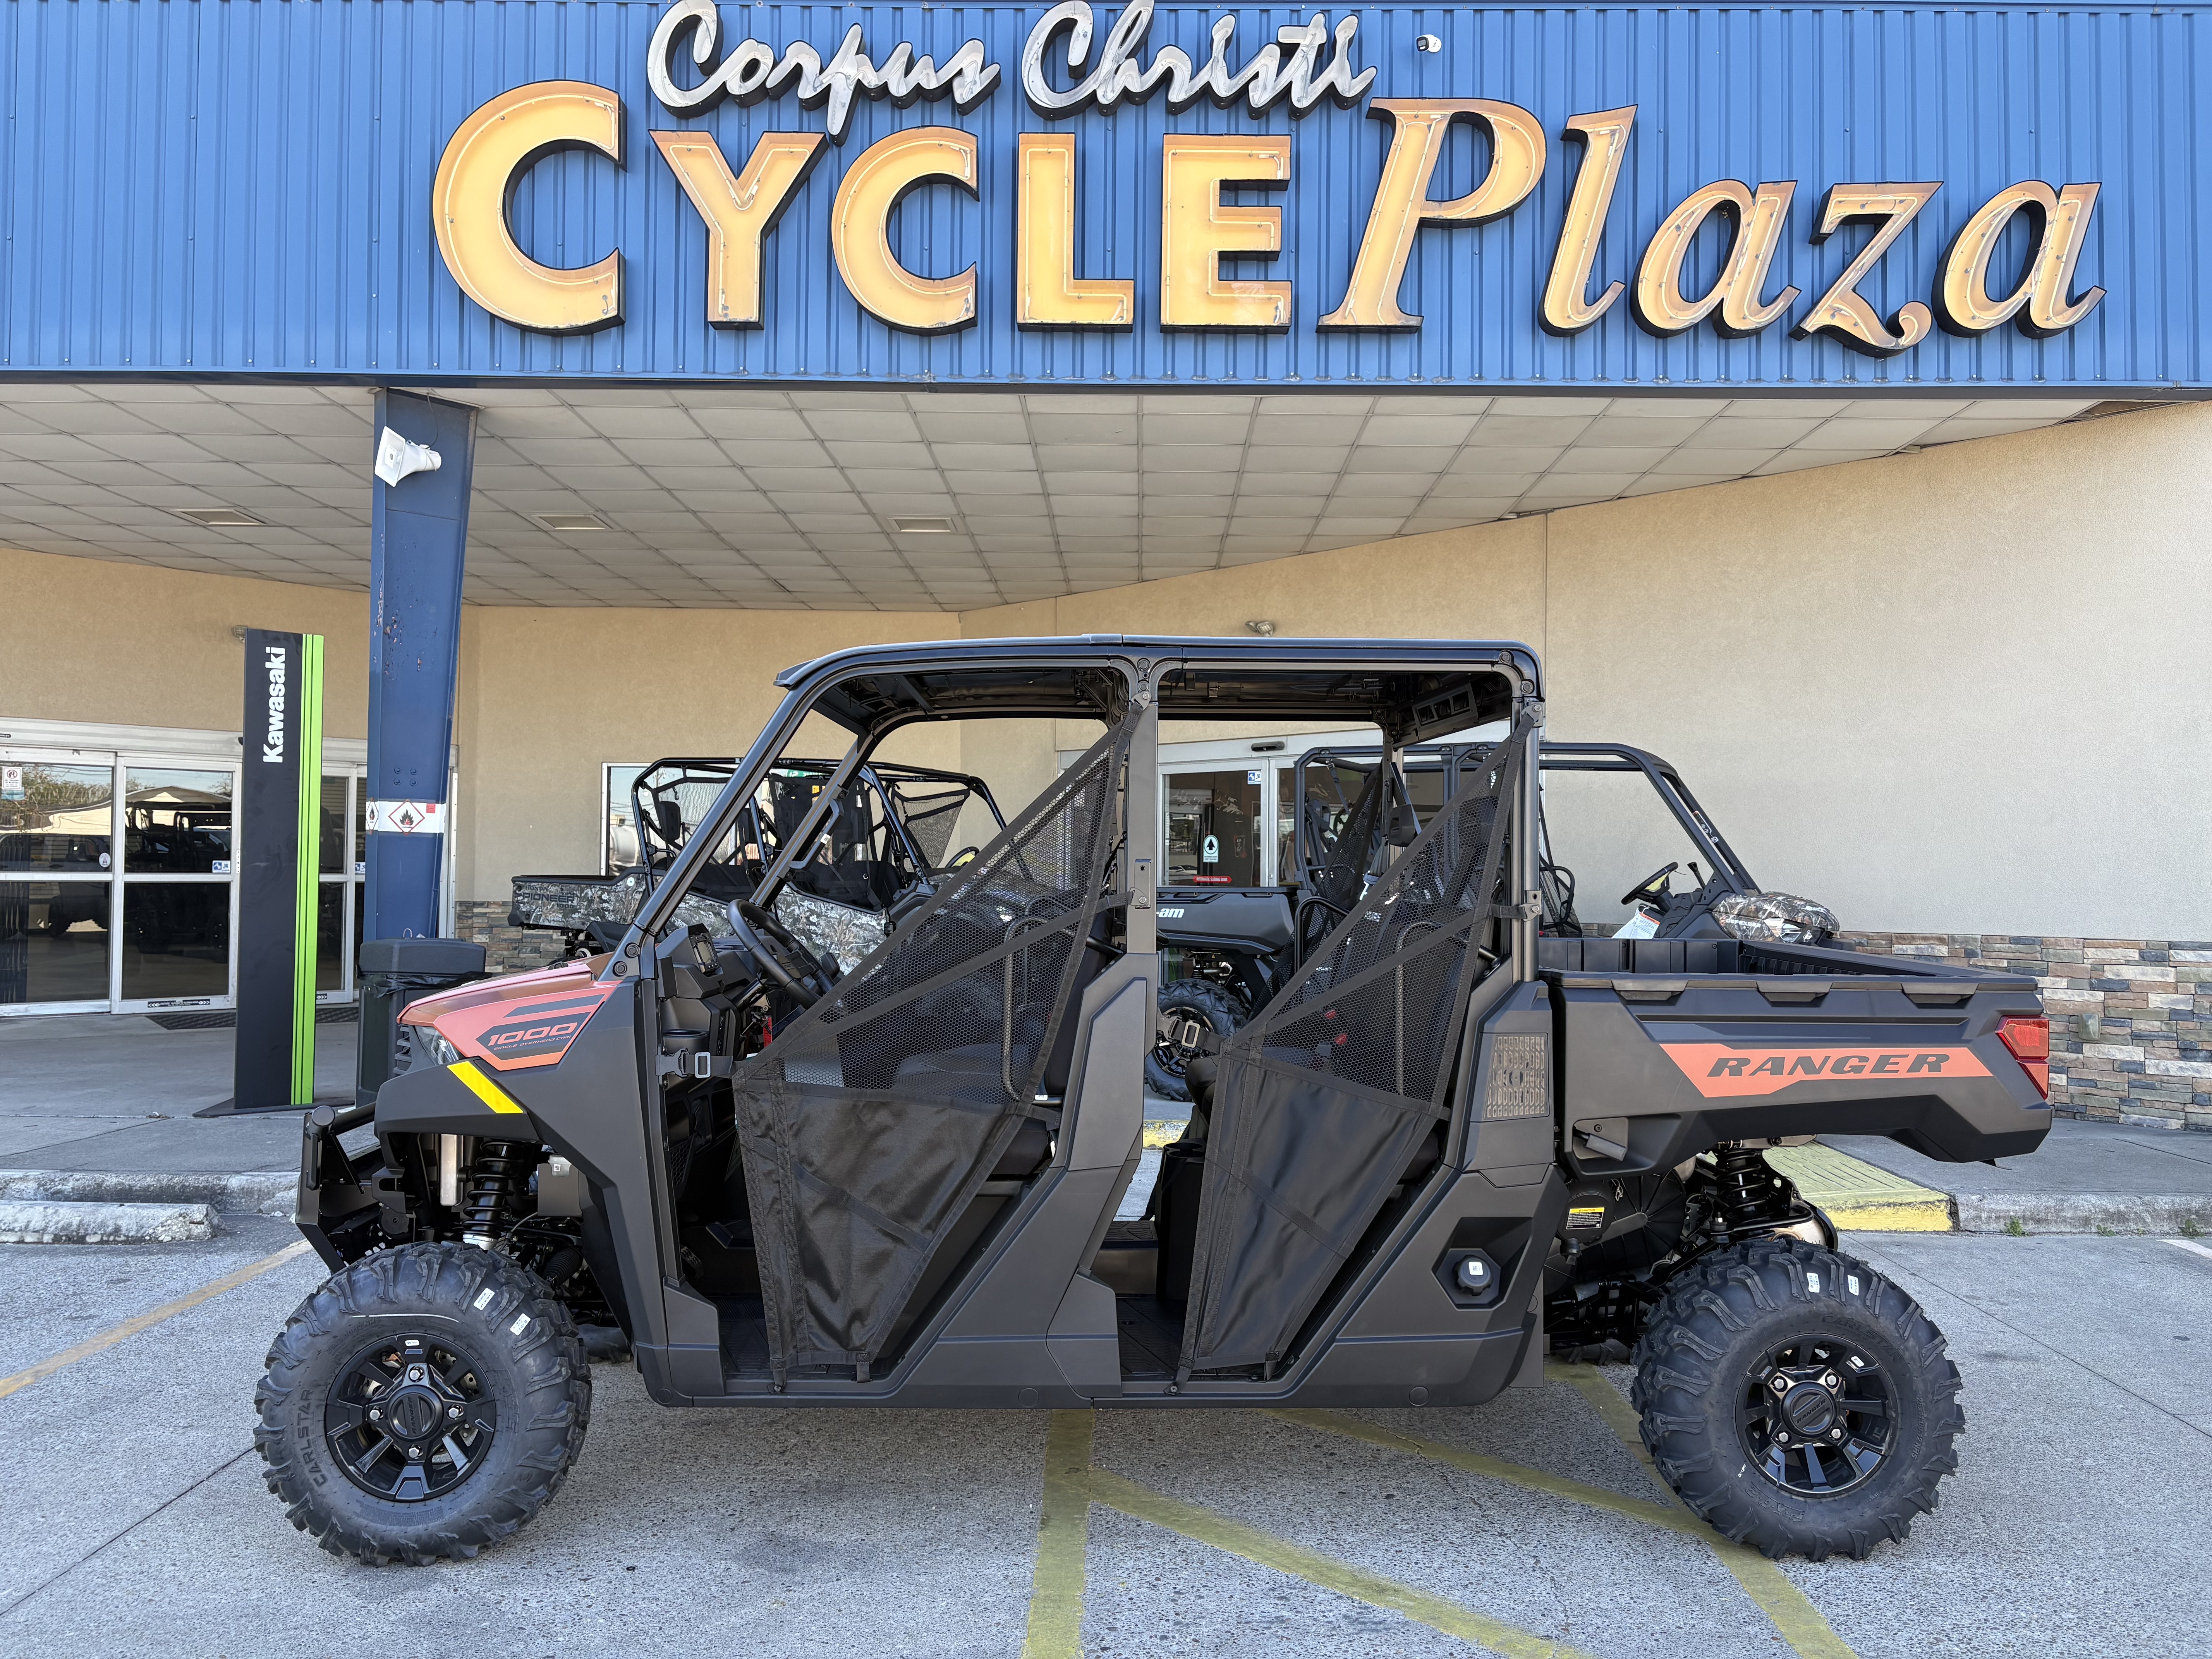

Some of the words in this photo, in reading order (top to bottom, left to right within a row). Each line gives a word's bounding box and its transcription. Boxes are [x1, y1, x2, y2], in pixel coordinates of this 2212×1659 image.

[647, 0, 1001, 145] Corpus
[1022, 0, 1377, 119] Christi
[432, 79, 1292, 335] CYCLE
[1316, 97, 2107, 356] Plaza
[263, 646, 285, 763] Kawasaki
[522, 892, 575, 903] PIONEER
[1726, 918, 1762, 928] DEFENDER
[488, 1022, 577, 1046] 1000
[520, 1038, 555, 1046] OVERHEAD
[1707, 1053, 1950, 1077] RANGER
[1821, 1314, 1904, 1363] CARLSTAR
[408, 1396, 416, 1434] RANGER
[1796, 1399, 1826, 1424] RANGER
[297, 1389, 328, 1487] CARLSTAR
